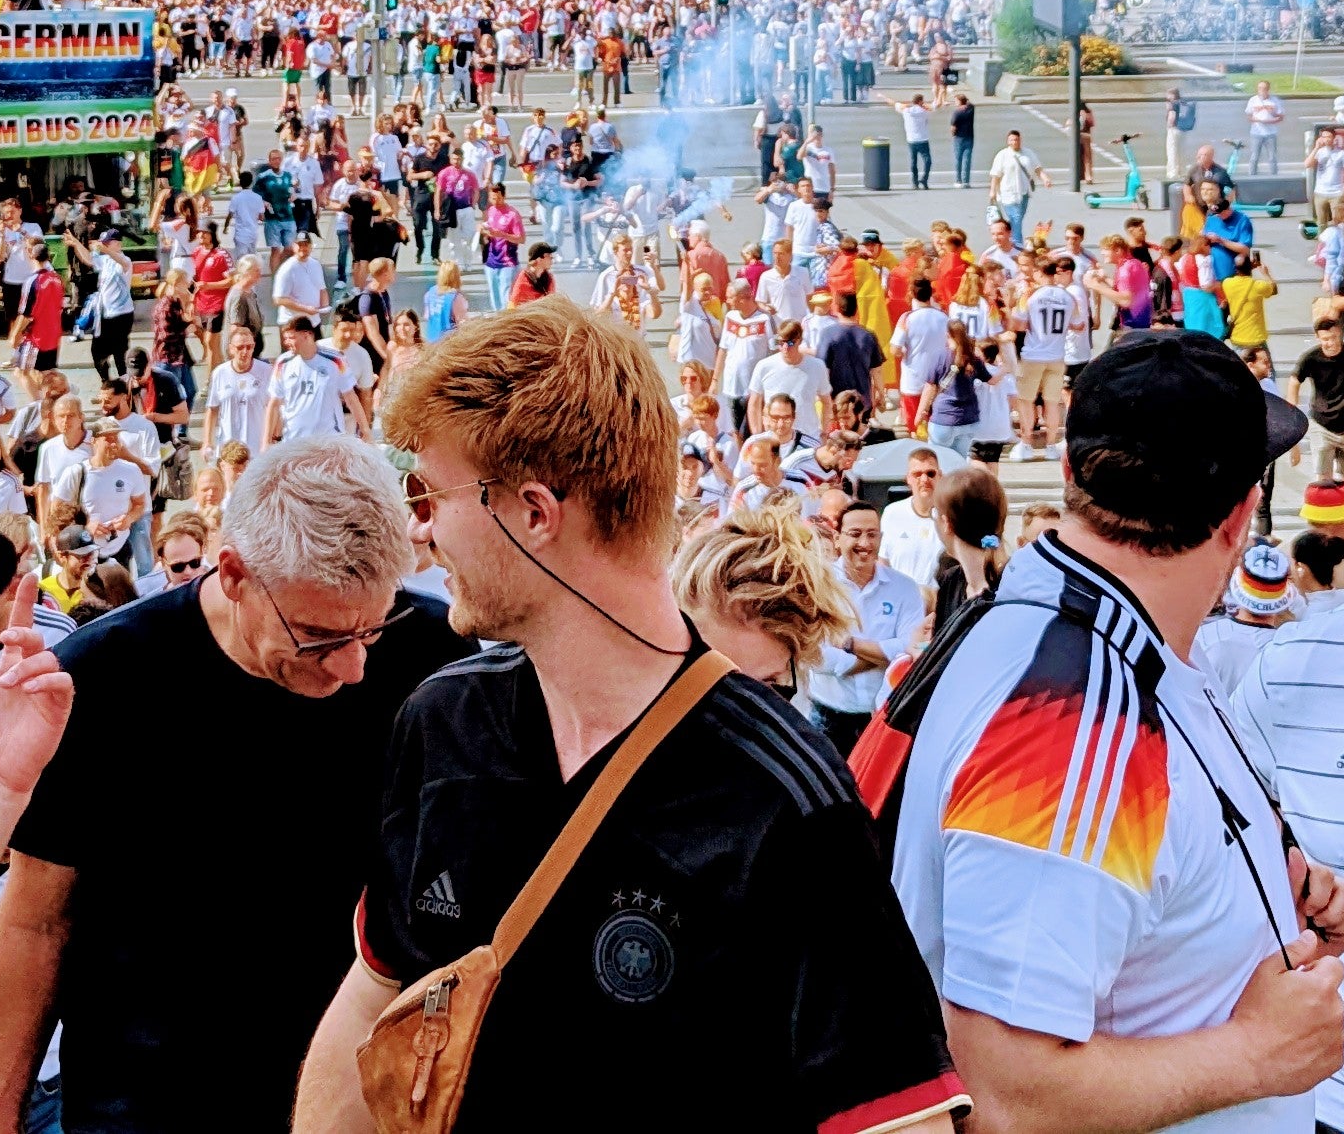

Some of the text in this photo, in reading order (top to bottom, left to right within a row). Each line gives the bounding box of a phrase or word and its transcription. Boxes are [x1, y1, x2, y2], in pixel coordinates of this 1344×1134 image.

[26, 117, 81, 144] BUS
[88, 114, 154, 140] 2024
[1040, 308, 1065, 334] 10
[416, 898, 461, 919] adidas
